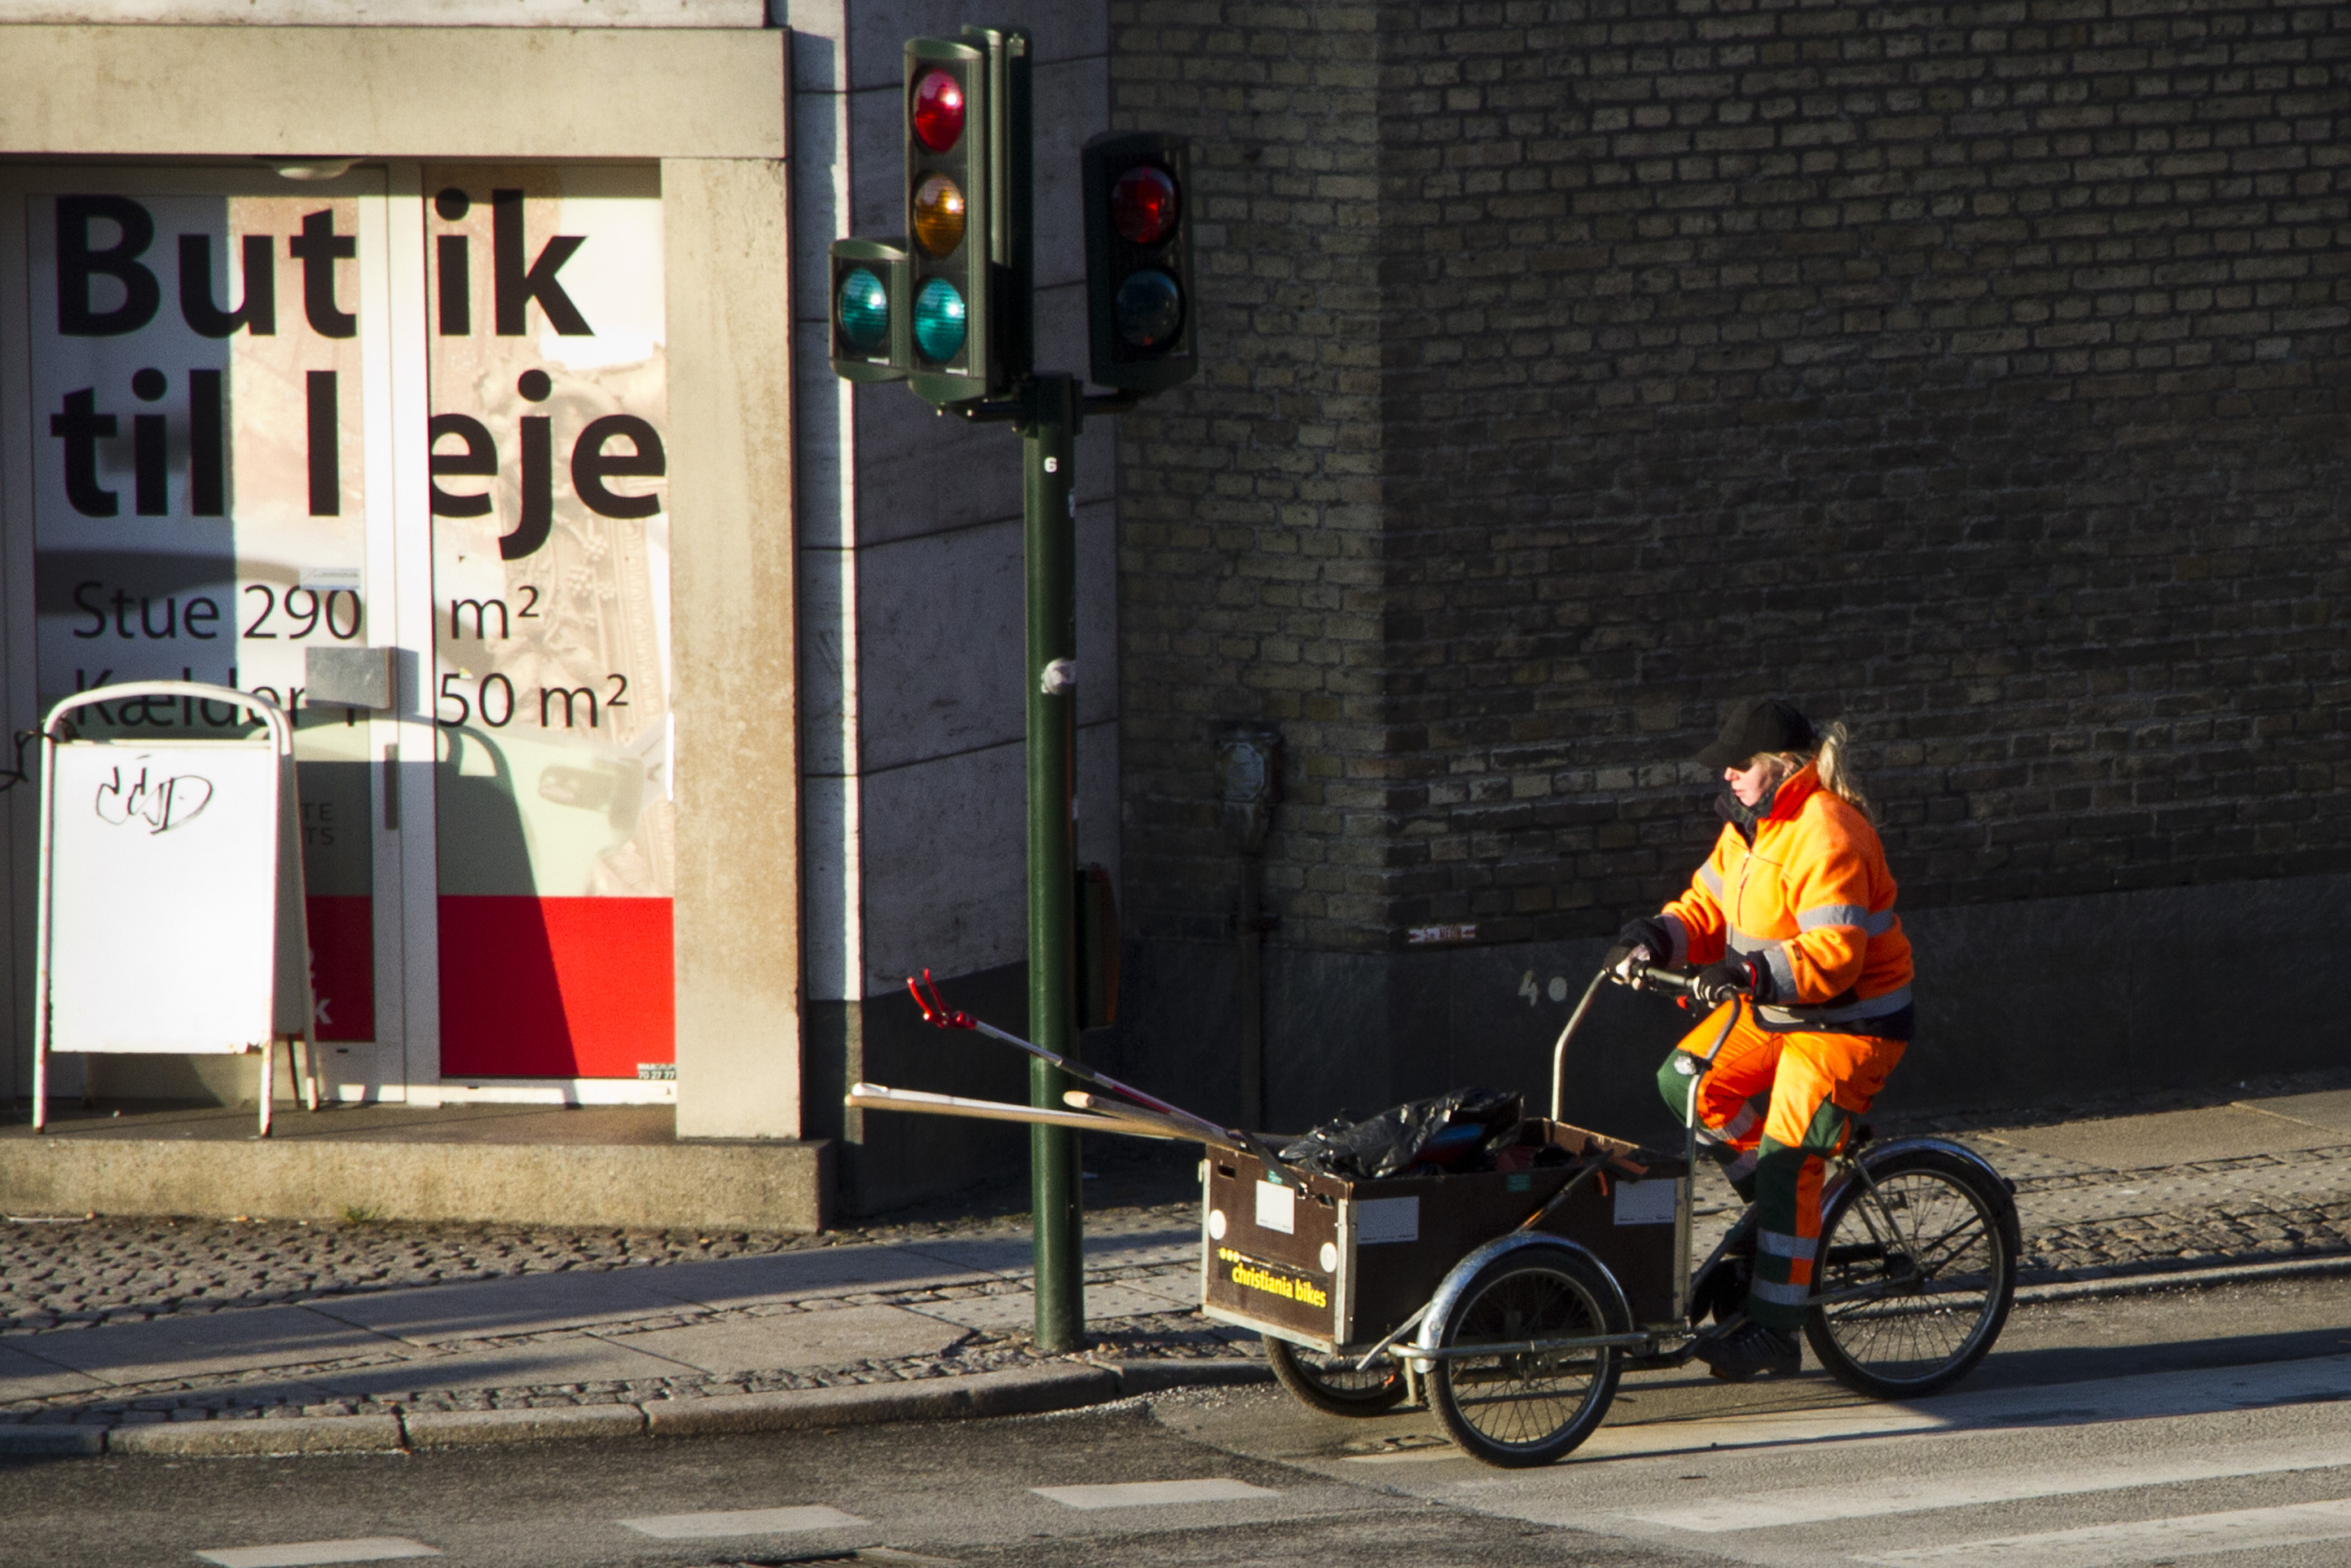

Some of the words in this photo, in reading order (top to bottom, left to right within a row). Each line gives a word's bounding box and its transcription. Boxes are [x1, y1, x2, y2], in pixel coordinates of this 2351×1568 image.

[51, 368, 225, 518] til
[74, 580, 220, 641] Stue
[244, 584, 363, 641] 290
[1231, 1262, 1294, 1299] christiania
[1294, 1278, 1327, 1308] bikes
